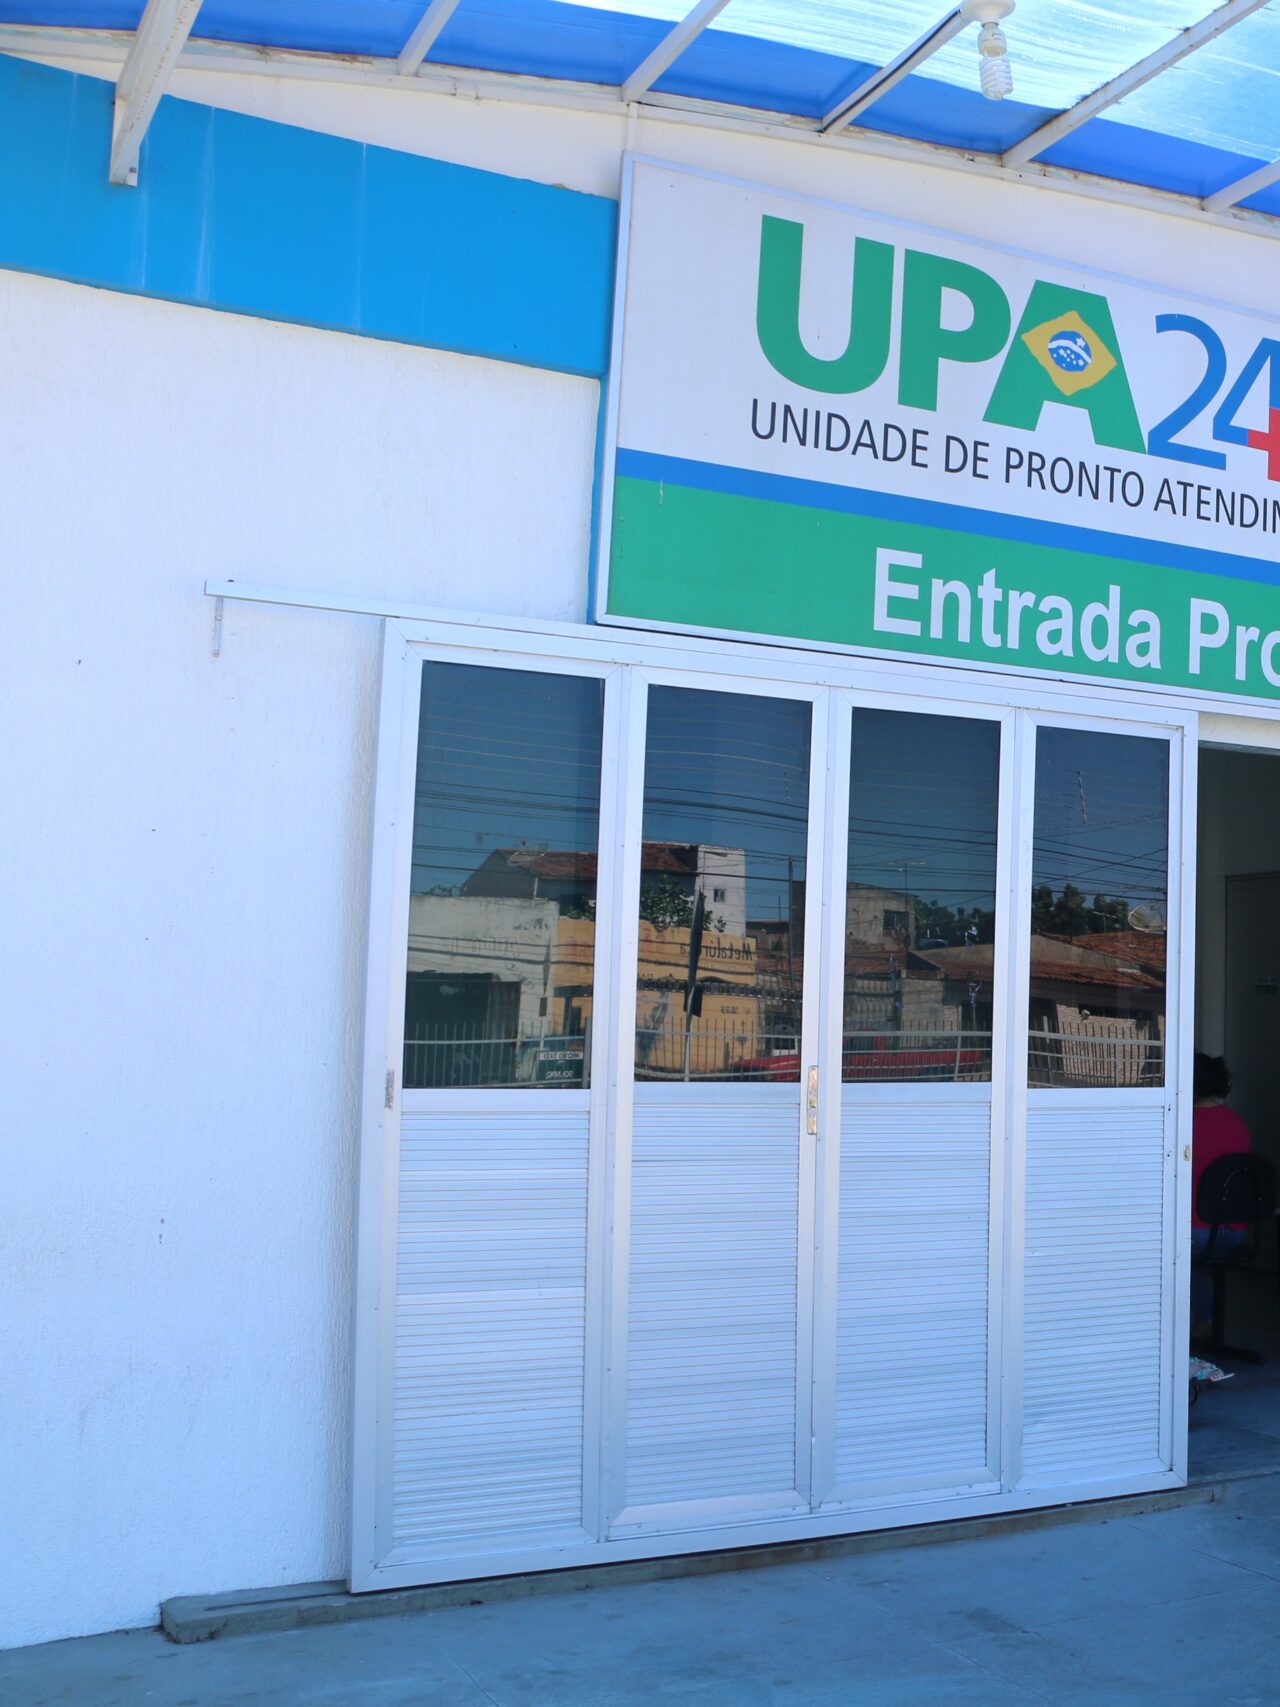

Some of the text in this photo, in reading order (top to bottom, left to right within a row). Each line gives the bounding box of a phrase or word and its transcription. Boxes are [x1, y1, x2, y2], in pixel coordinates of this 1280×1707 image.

[751, 398, 928, 469] UNIDADE
[943, 435, 989, 481] DE
[1005, 447, 1145, 509] PRONTO
[873, 546, 1162, 670] Entrada
